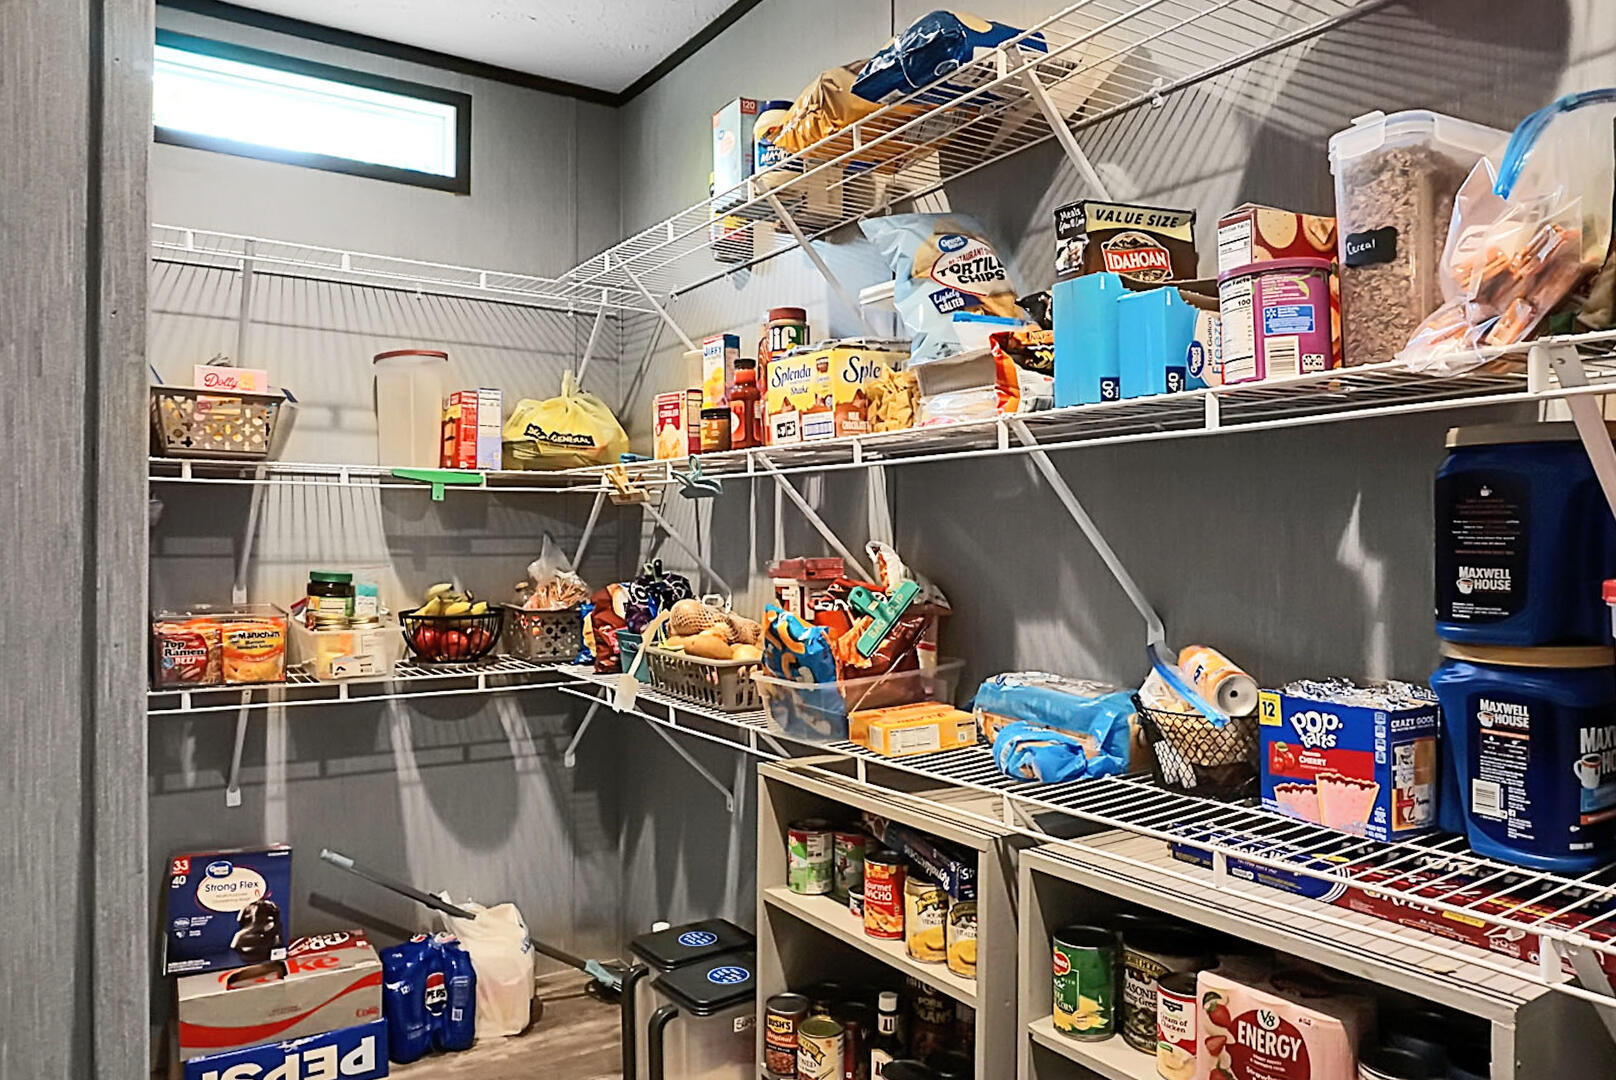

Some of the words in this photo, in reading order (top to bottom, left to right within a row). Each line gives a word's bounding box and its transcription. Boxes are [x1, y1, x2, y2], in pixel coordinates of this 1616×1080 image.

[742, 100, 756, 109] 120
[1096, 208, 1143, 224] VALUE
[1147, 214, 1179, 228] SIZE
[1347, 238, 1376, 255] Cereal
[1107, 251, 1167, 270] IDAHOAN
[957, 269, 1005, 284] CHIPS
[933, 288, 960, 304] Lightly
[1238, 298, 1251, 307] 100
[939, 297, 965, 313] SALTED
[204, 372, 238, 390] Dolly
[771, 363, 811, 388] Splenda
[1168, 372, 1180, 392] 40
[1102, 380, 1115, 399] 60
[1459, 566, 1511, 580] MAXWELL
[1474, 579, 1511, 591] HOUSE
[886, 594, 905, 616] CLIP
[239, 631, 280, 640] Maruchan
[164, 640, 185, 649] Top
[164, 648, 207, 657] Ramen
[1261, 701, 1275, 717] 12
[1480, 698, 1530, 718] MAXWELL
[1390, 718, 1415, 729] CRAZY
[1494, 712, 1530, 729] HOUSE
[1298, 755, 1327, 766] CHERRY
[173, 860, 189, 871] 33
[172, 875, 186, 886] 40
[205, 883, 237, 893] Strong
[239, 880, 259, 889] Flex
[1260, 1009, 1276, 1027] V8
[767, 1031, 793, 1043] Original
[1237, 1020, 1302, 1062] ENERGY
